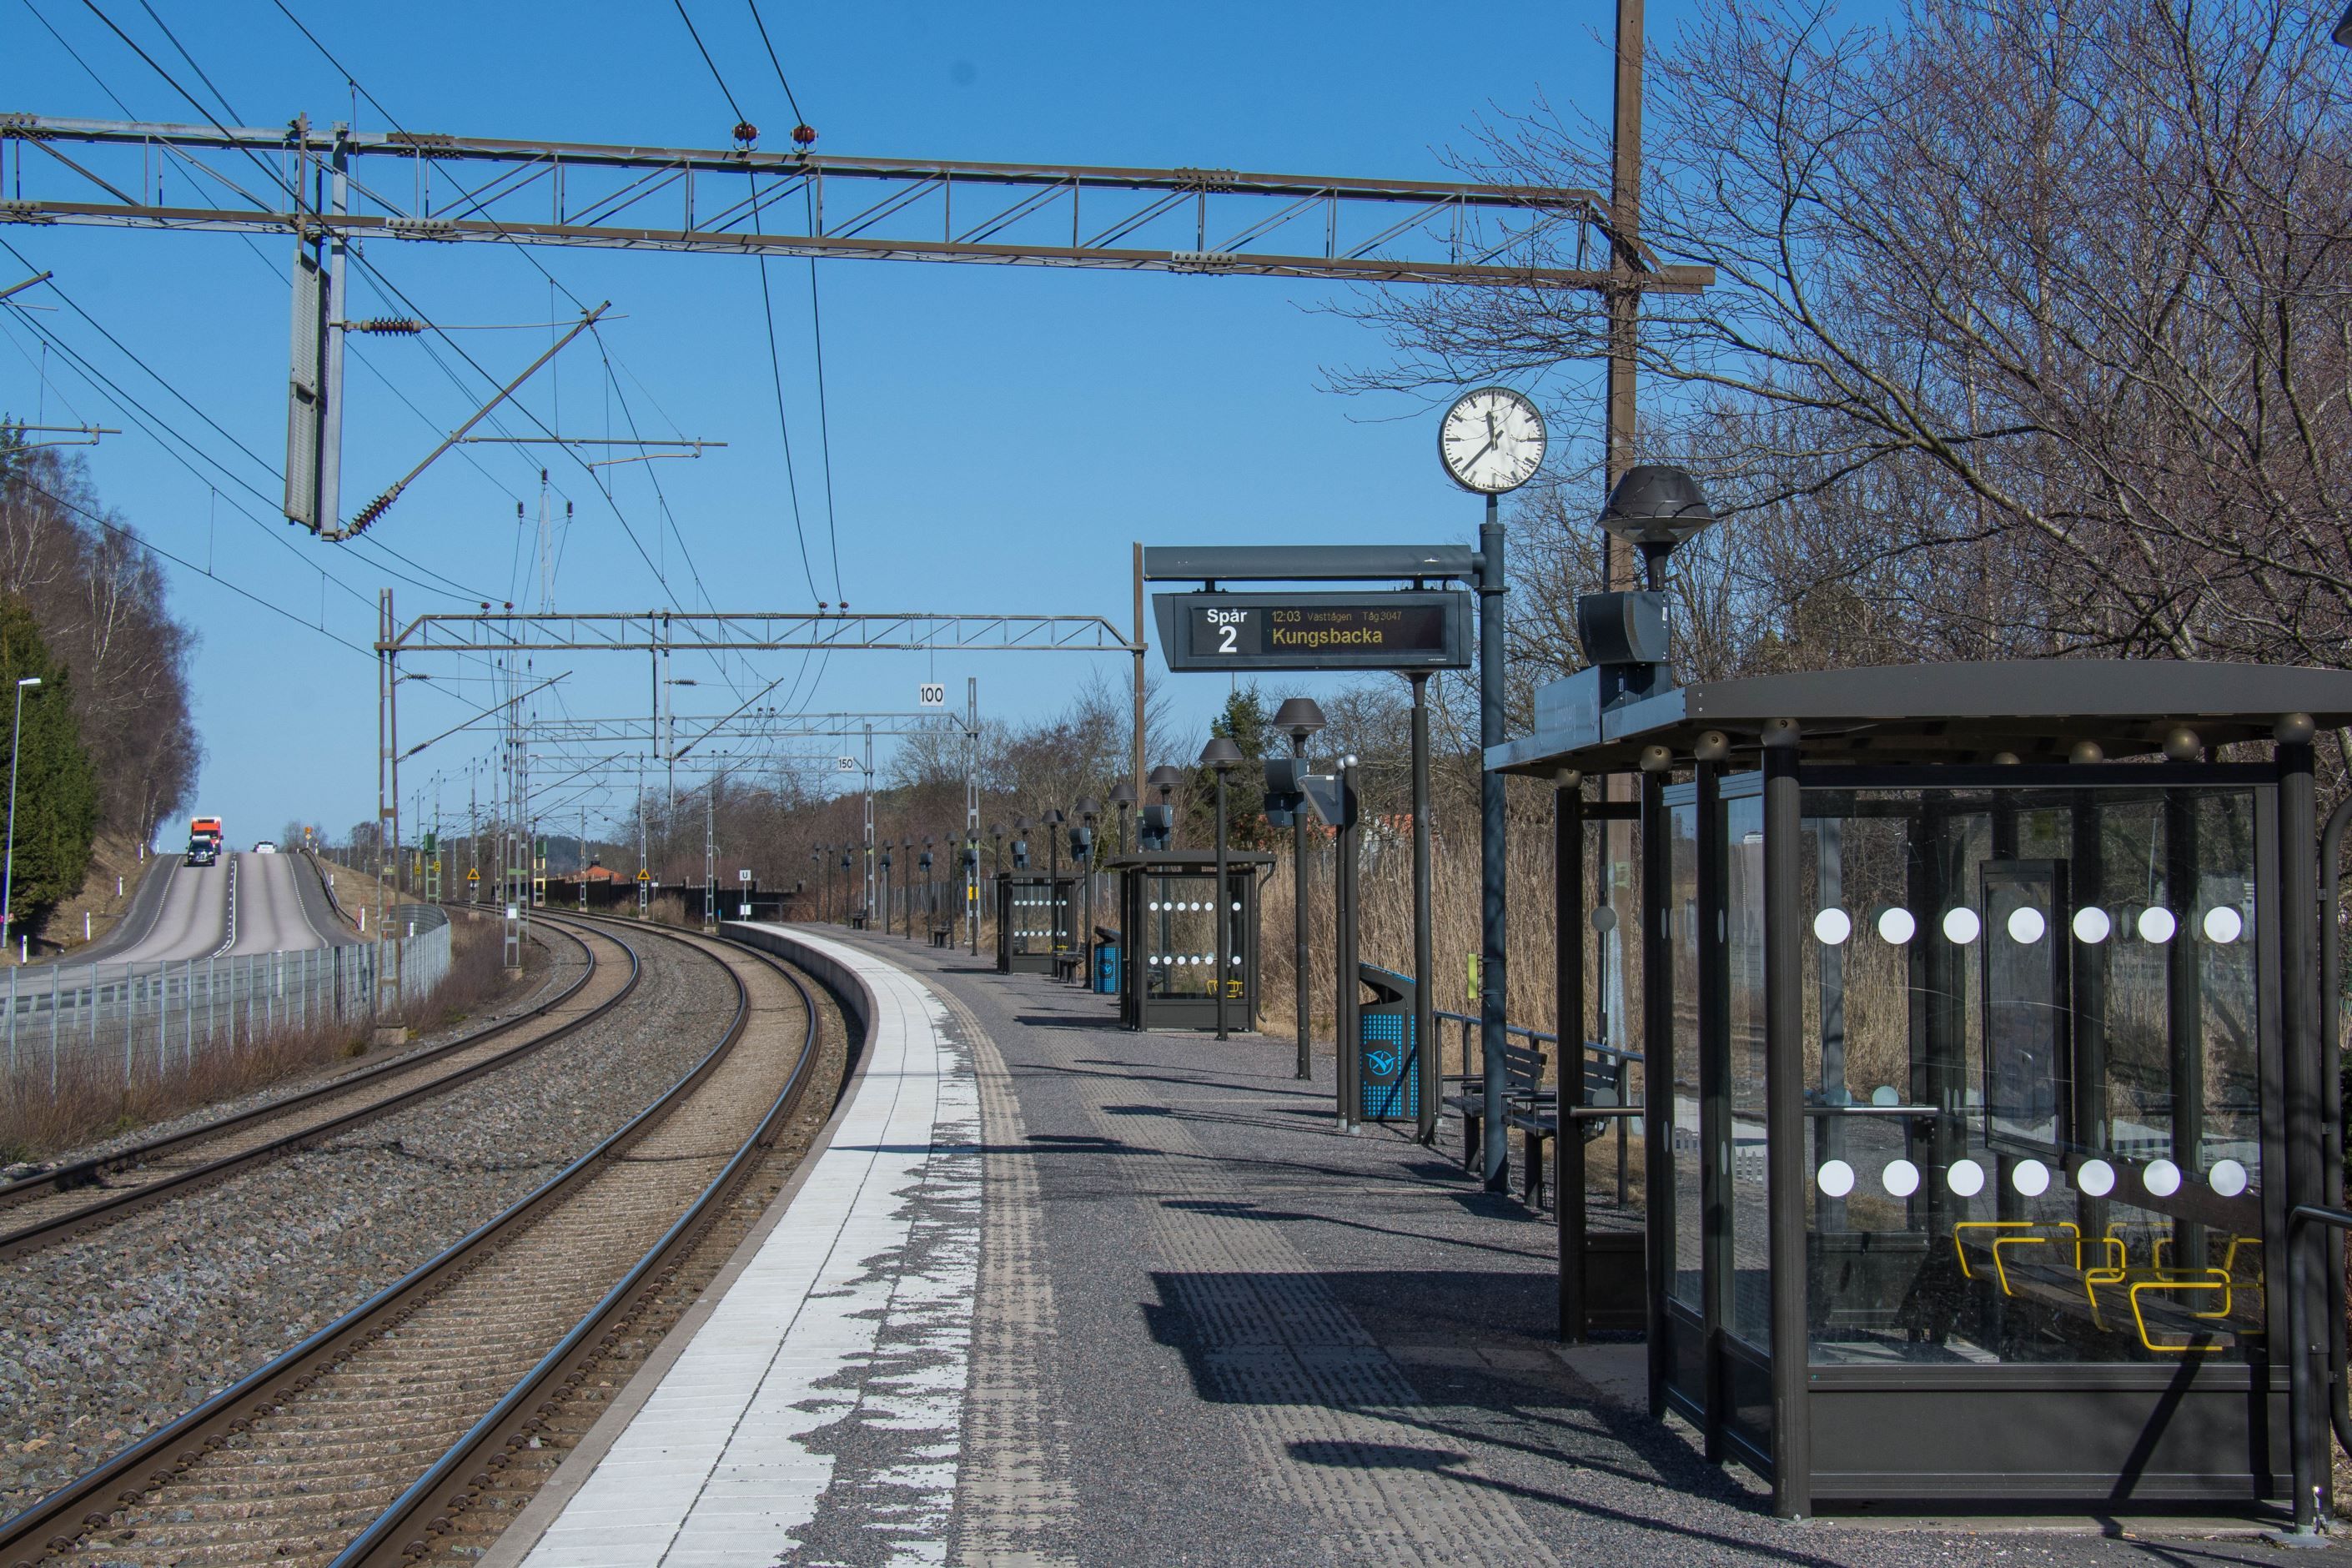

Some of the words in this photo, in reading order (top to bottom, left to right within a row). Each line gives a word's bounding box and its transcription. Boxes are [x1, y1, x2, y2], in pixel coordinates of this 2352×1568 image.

[1207, 609, 1248, 626] Spår
[1272, 611, 1301, 622] 12:03
[1380, 611, 1402, 621] 3047
[1219, 626, 1238, 653] 2
[1273, 627, 1383, 648] Kungsbacka
[921, 687, 943, 702] 100
[839, 759, 852, 769] 150
